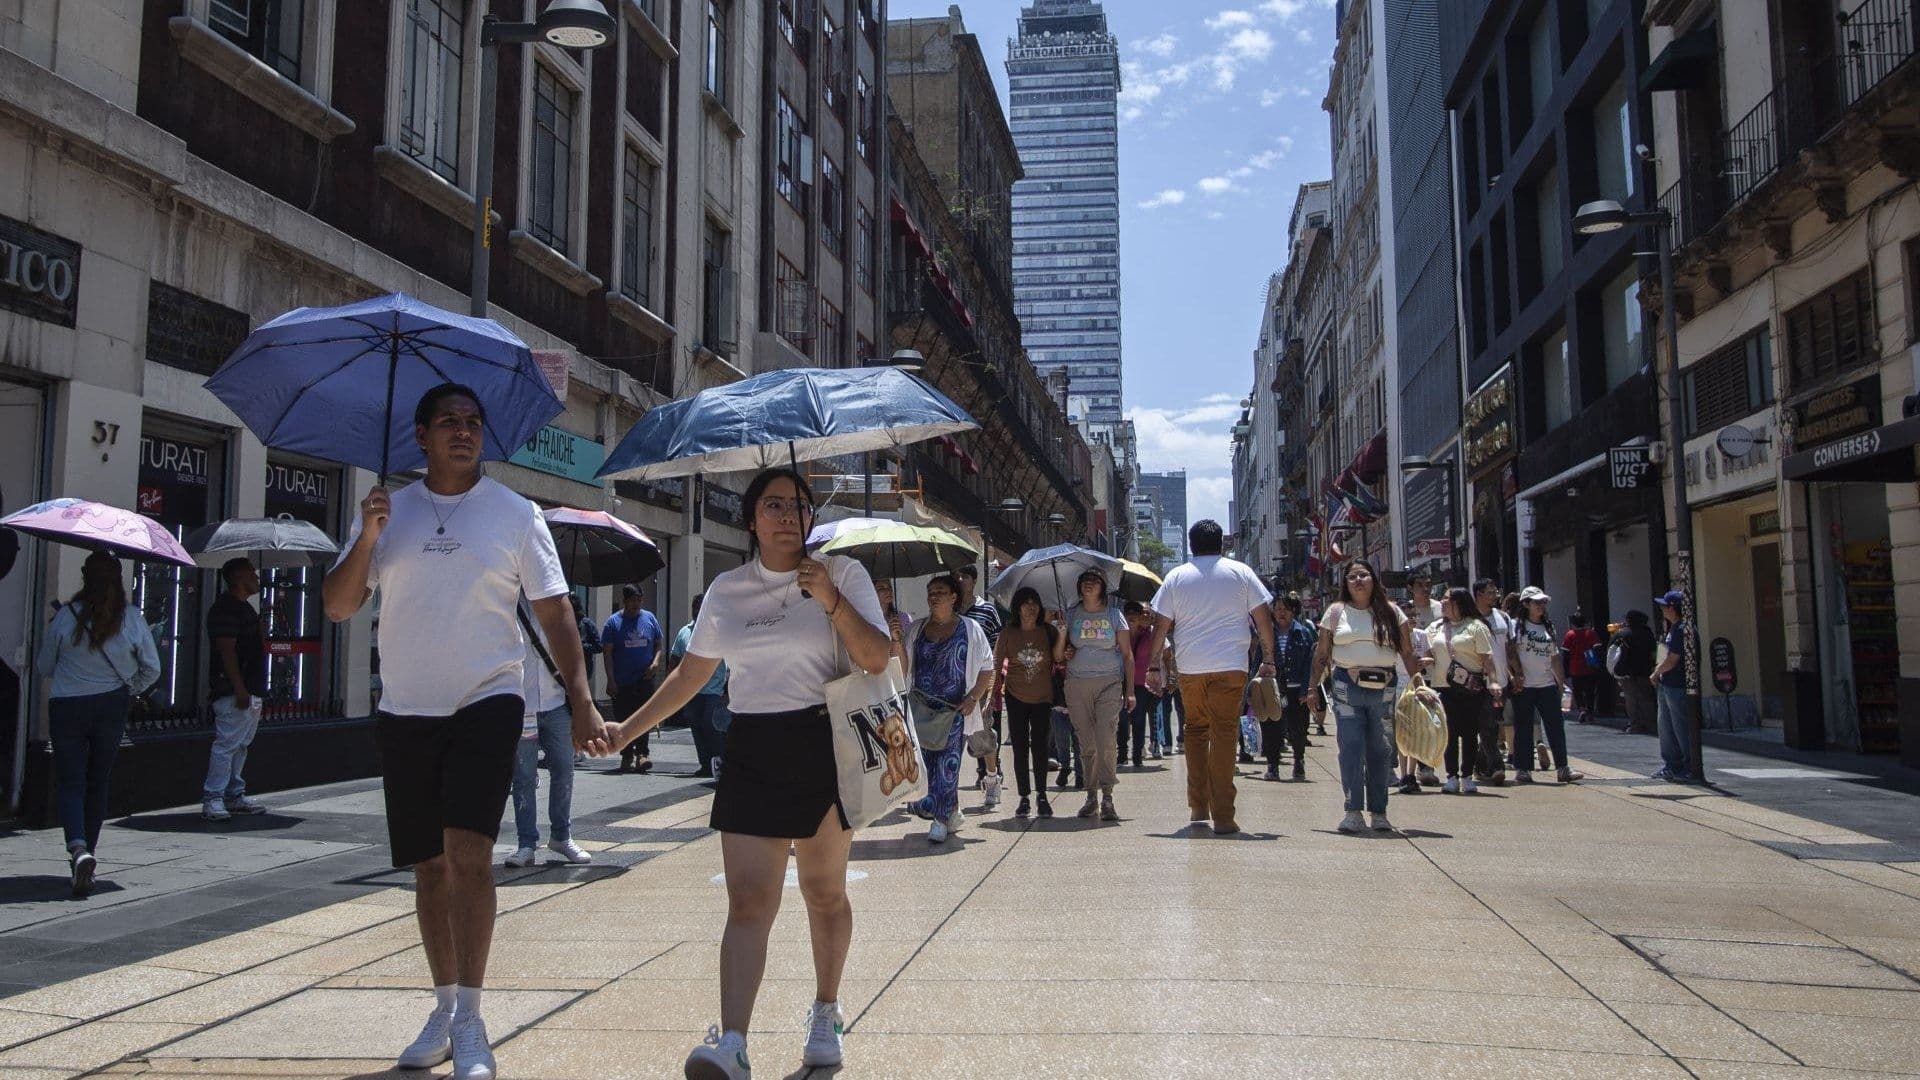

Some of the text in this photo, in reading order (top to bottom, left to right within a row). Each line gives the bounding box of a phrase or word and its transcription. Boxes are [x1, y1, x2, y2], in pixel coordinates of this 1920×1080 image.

[1013, 43, 1109, 58] LATINOAMERICANA
[92, 420, 120, 446] 37
[139, 438, 208, 476] TURATI
[1614, 450, 1641, 463] INN
[1814, 435, 1869, 467] CONVERSE
[1615, 462, 1650, 476] VICT
[1616, 476, 1637, 488] US
